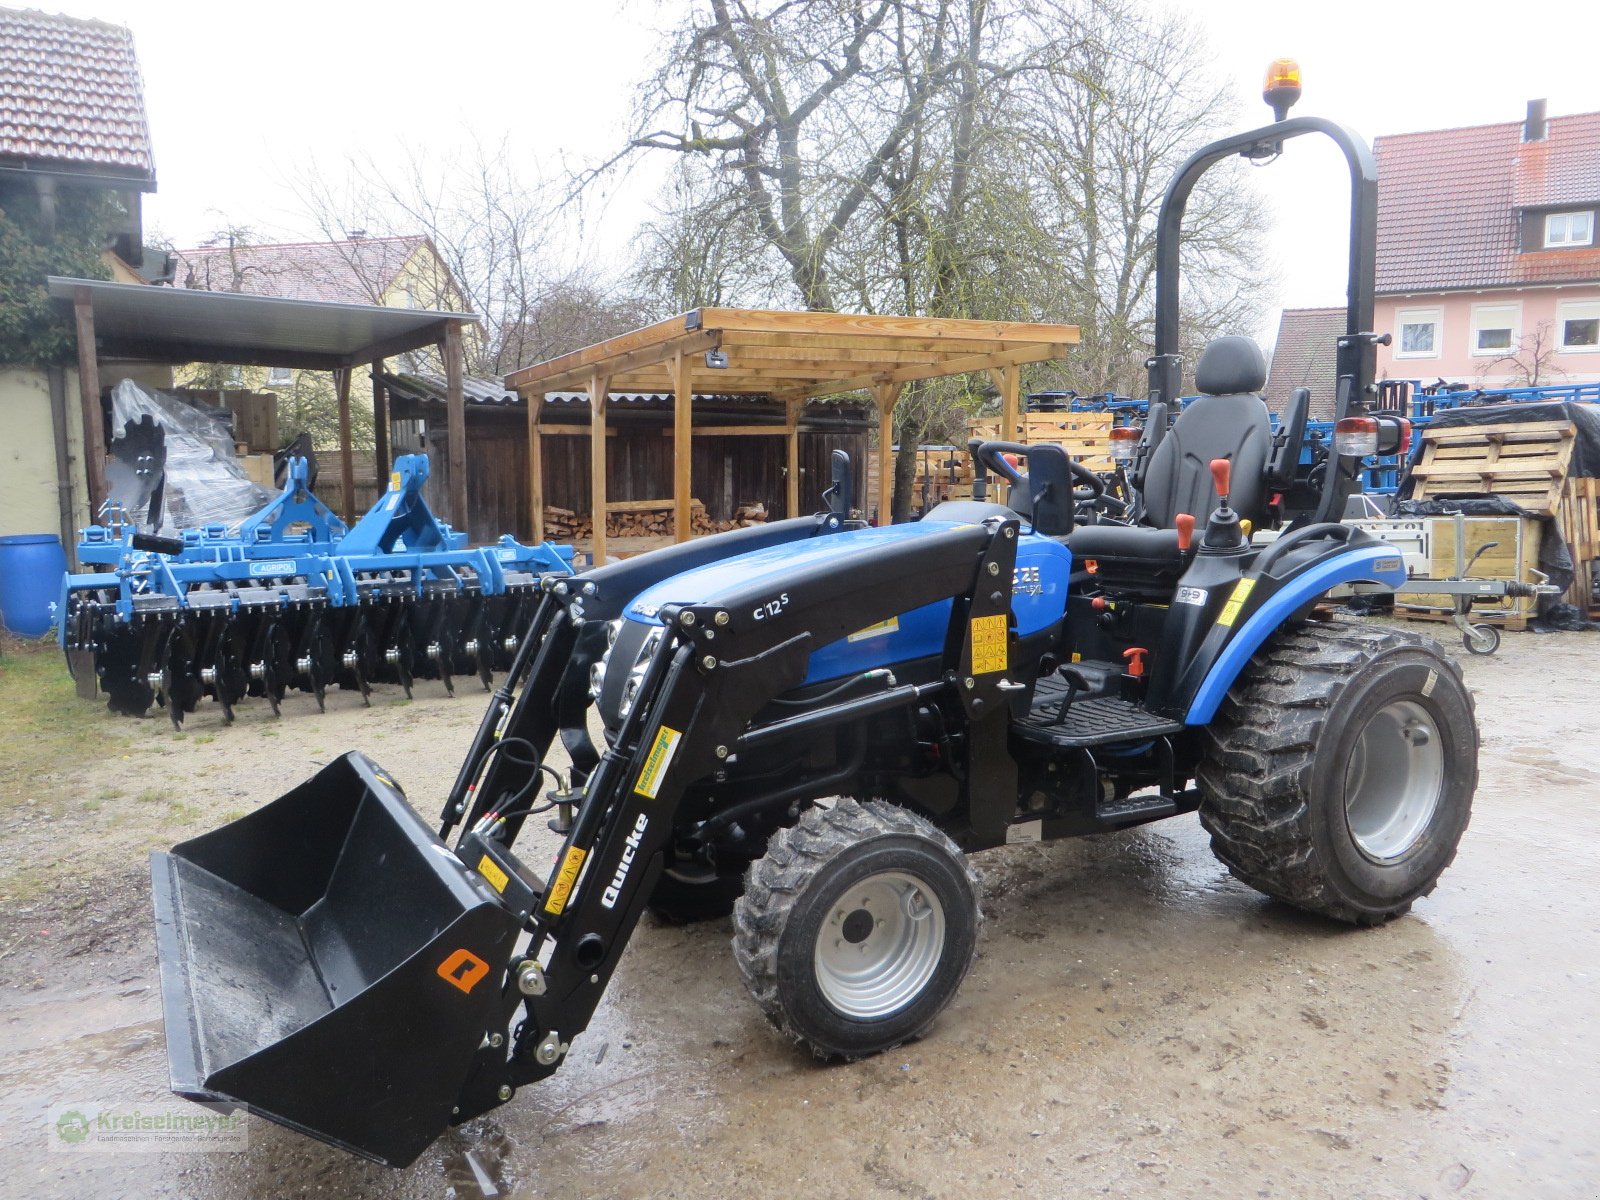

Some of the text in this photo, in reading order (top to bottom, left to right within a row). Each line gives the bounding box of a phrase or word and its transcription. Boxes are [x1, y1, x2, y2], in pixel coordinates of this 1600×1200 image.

[261, 563, 294, 572] AGRIPOL
[1181, 589, 1201, 599] 9+9
[601, 812, 649, 909] Quicke
